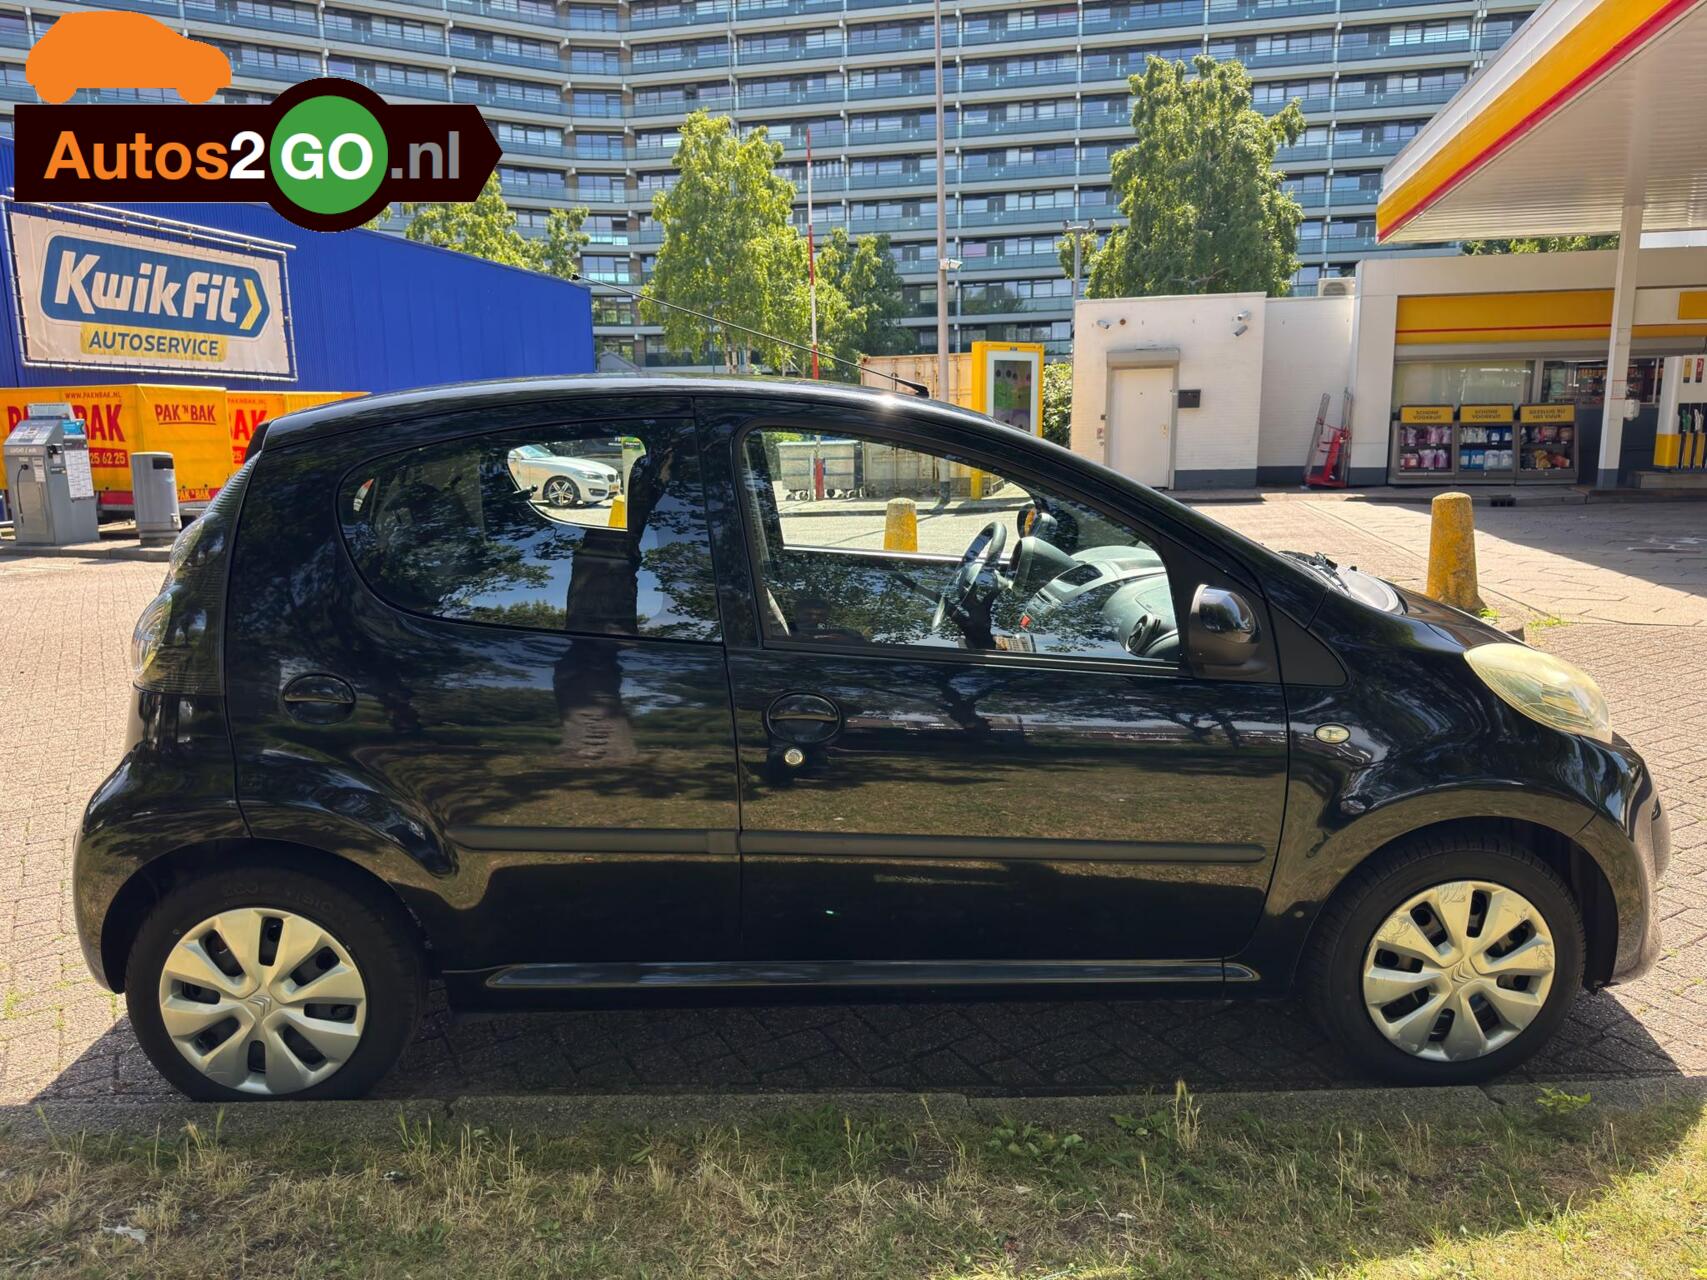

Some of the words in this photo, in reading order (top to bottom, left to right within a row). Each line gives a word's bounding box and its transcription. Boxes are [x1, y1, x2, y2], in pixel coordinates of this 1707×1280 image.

[88, 330, 219, 357] AUTOSERVICE
[154, 404, 181, 422] PAK
[190, 404, 217, 422] BAK
[228, 408, 268, 441] AK
[102, 452, 113, 465] 62
[113, 452, 126, 465] 25
